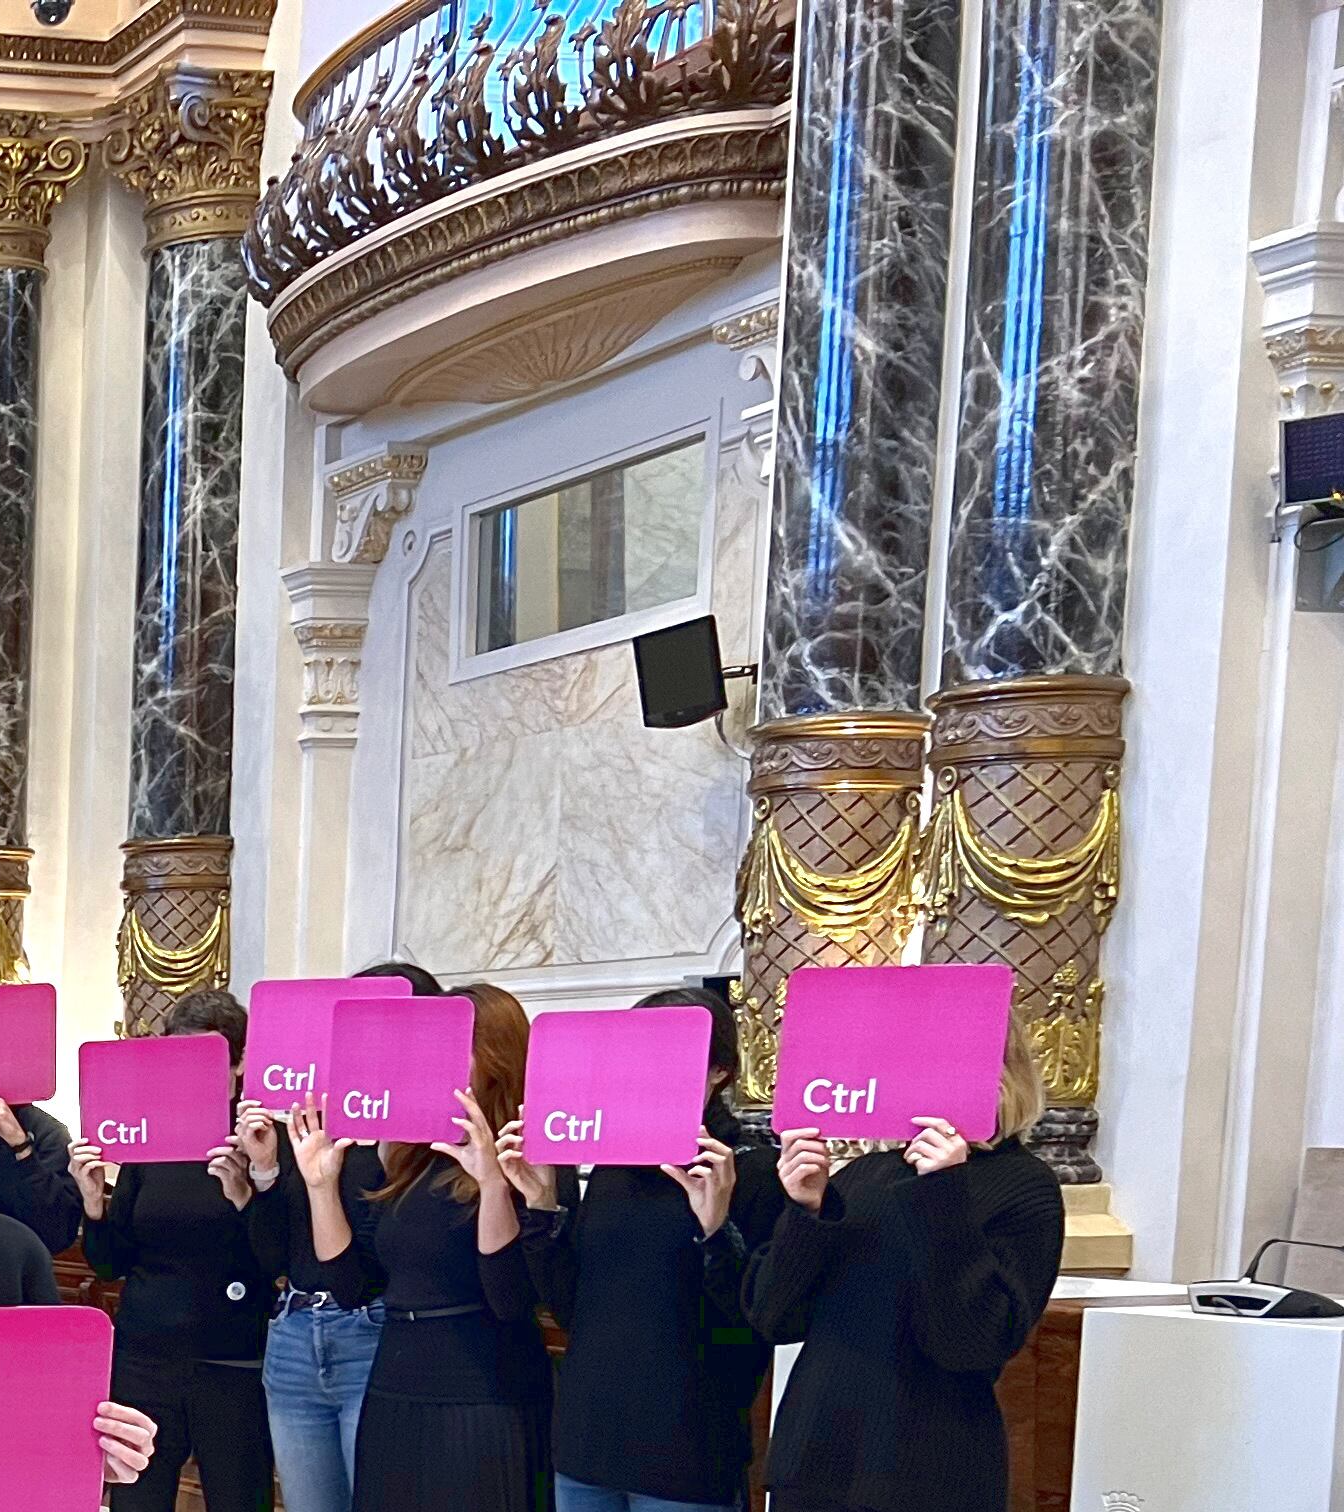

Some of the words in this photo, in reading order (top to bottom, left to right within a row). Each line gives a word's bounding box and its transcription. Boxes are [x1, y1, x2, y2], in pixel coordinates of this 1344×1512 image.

[263, 1063, 315, 1091] Ctrl
[343, 1089, 390, 1120] Ctrl
[804, 1077, 876, 1114] Ctrl
[97, 1117, 147, 1145] Ctrl
[543, 1109, 602, 1142] Ctrl
